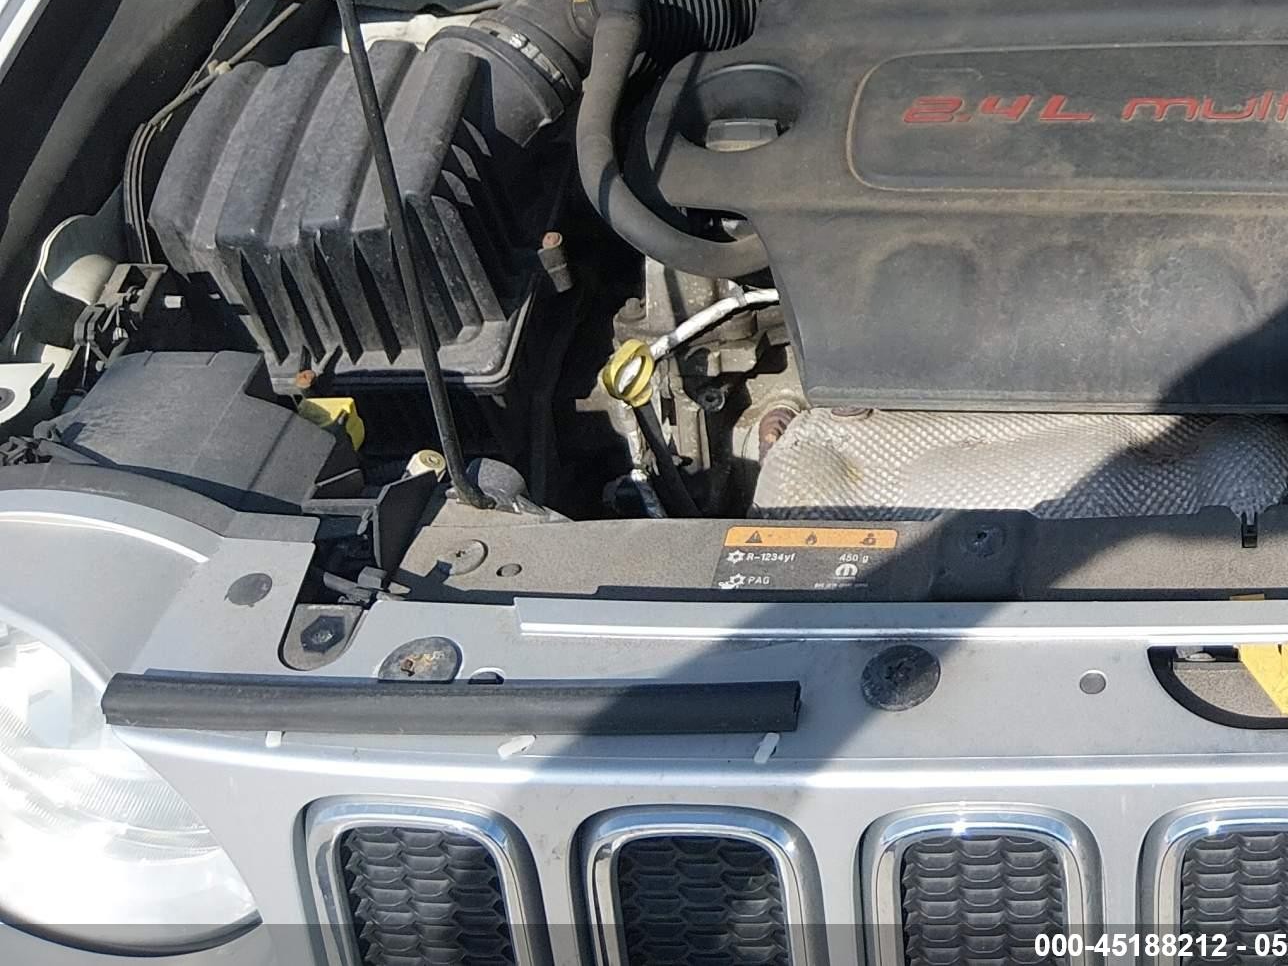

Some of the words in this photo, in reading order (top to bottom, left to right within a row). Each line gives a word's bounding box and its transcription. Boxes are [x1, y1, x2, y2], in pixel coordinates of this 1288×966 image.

[903, 94, 1097, 123] 2.4L
[746, 552, 796, 563] R-1234yf
[839, 553, 859, 562] 450
[862, 555, 869, 563] g
